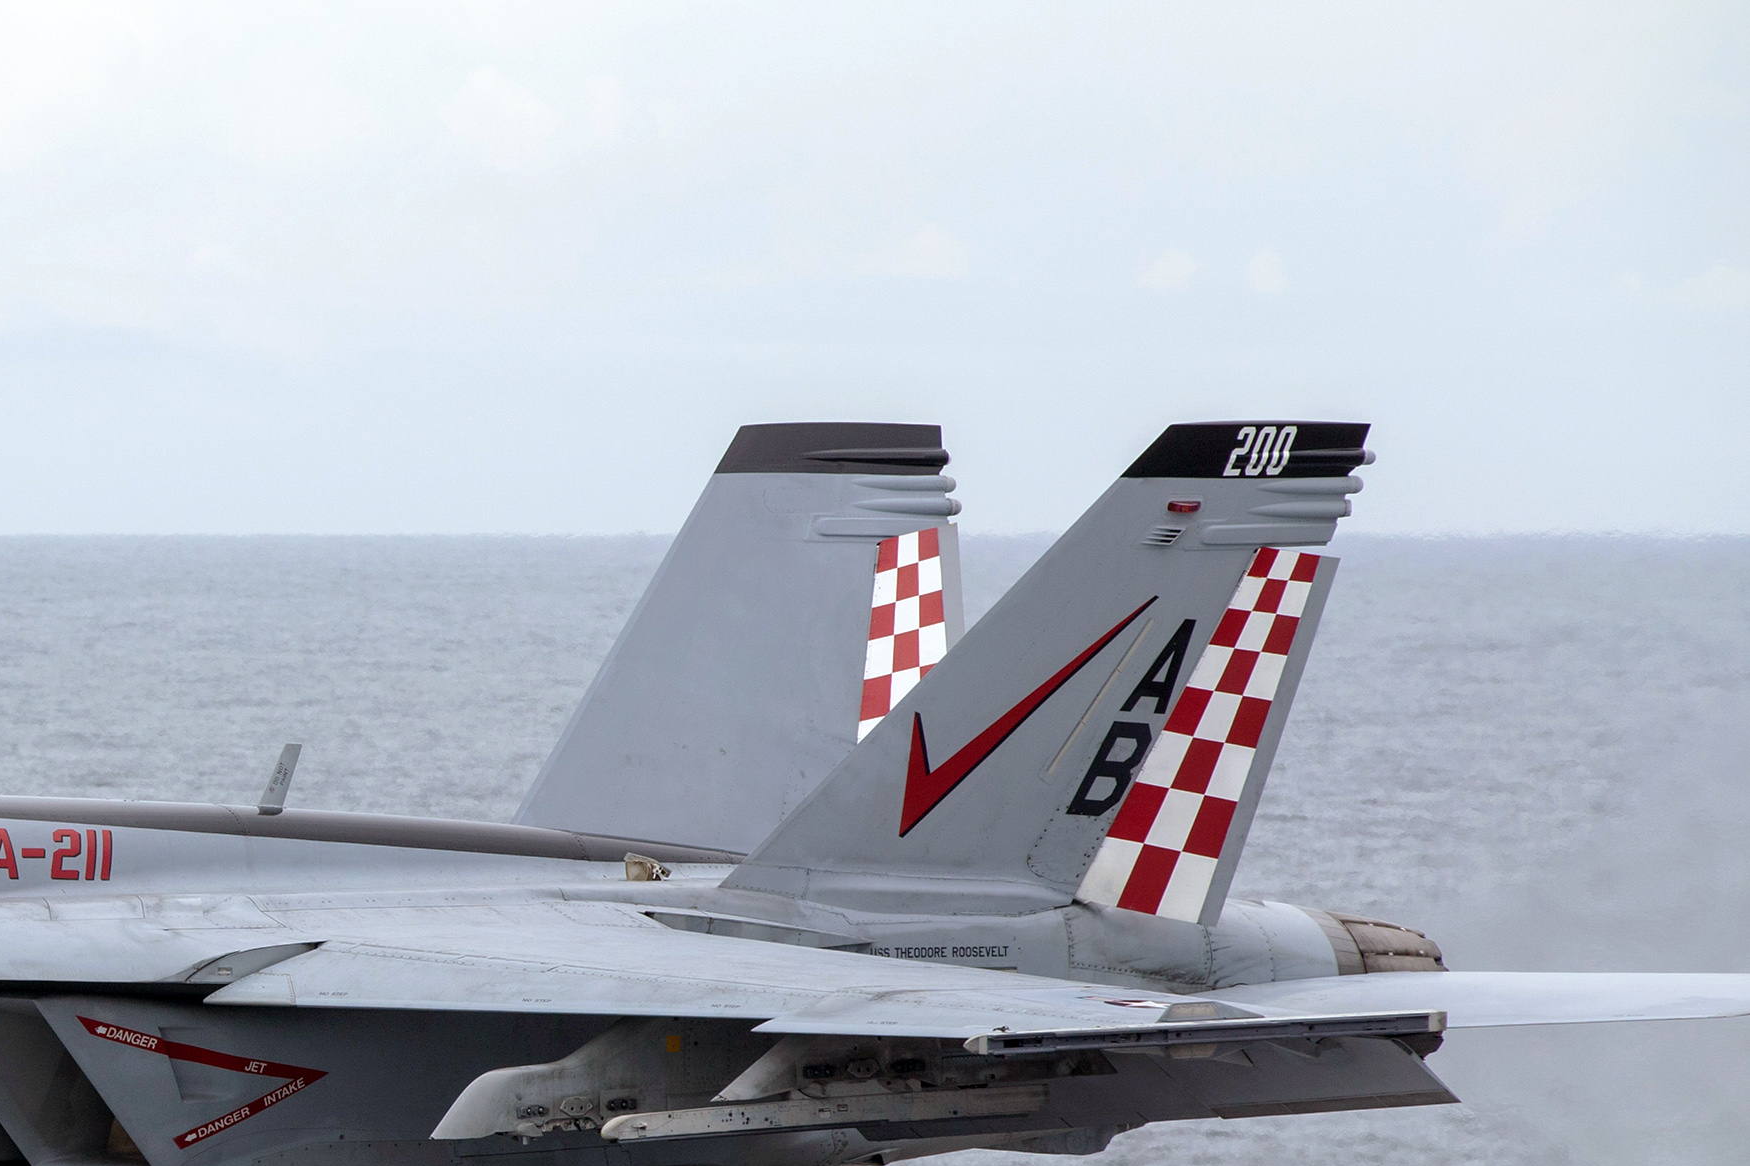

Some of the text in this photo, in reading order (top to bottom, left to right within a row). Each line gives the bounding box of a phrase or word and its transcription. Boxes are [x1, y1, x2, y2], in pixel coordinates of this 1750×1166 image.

[1222, 425, 1298, 477] 200
[276, 762, 285, 776] NOT
[279, 768, 290, 786] PAINT
[894, 947, 948, 959] THEODORE
[952, 945, 1009, 958] ROOSEVELT
[105, 1027, 268, 1075] DANGER JET
[196, 1077, 306, 1139] DANGER INTAKE
